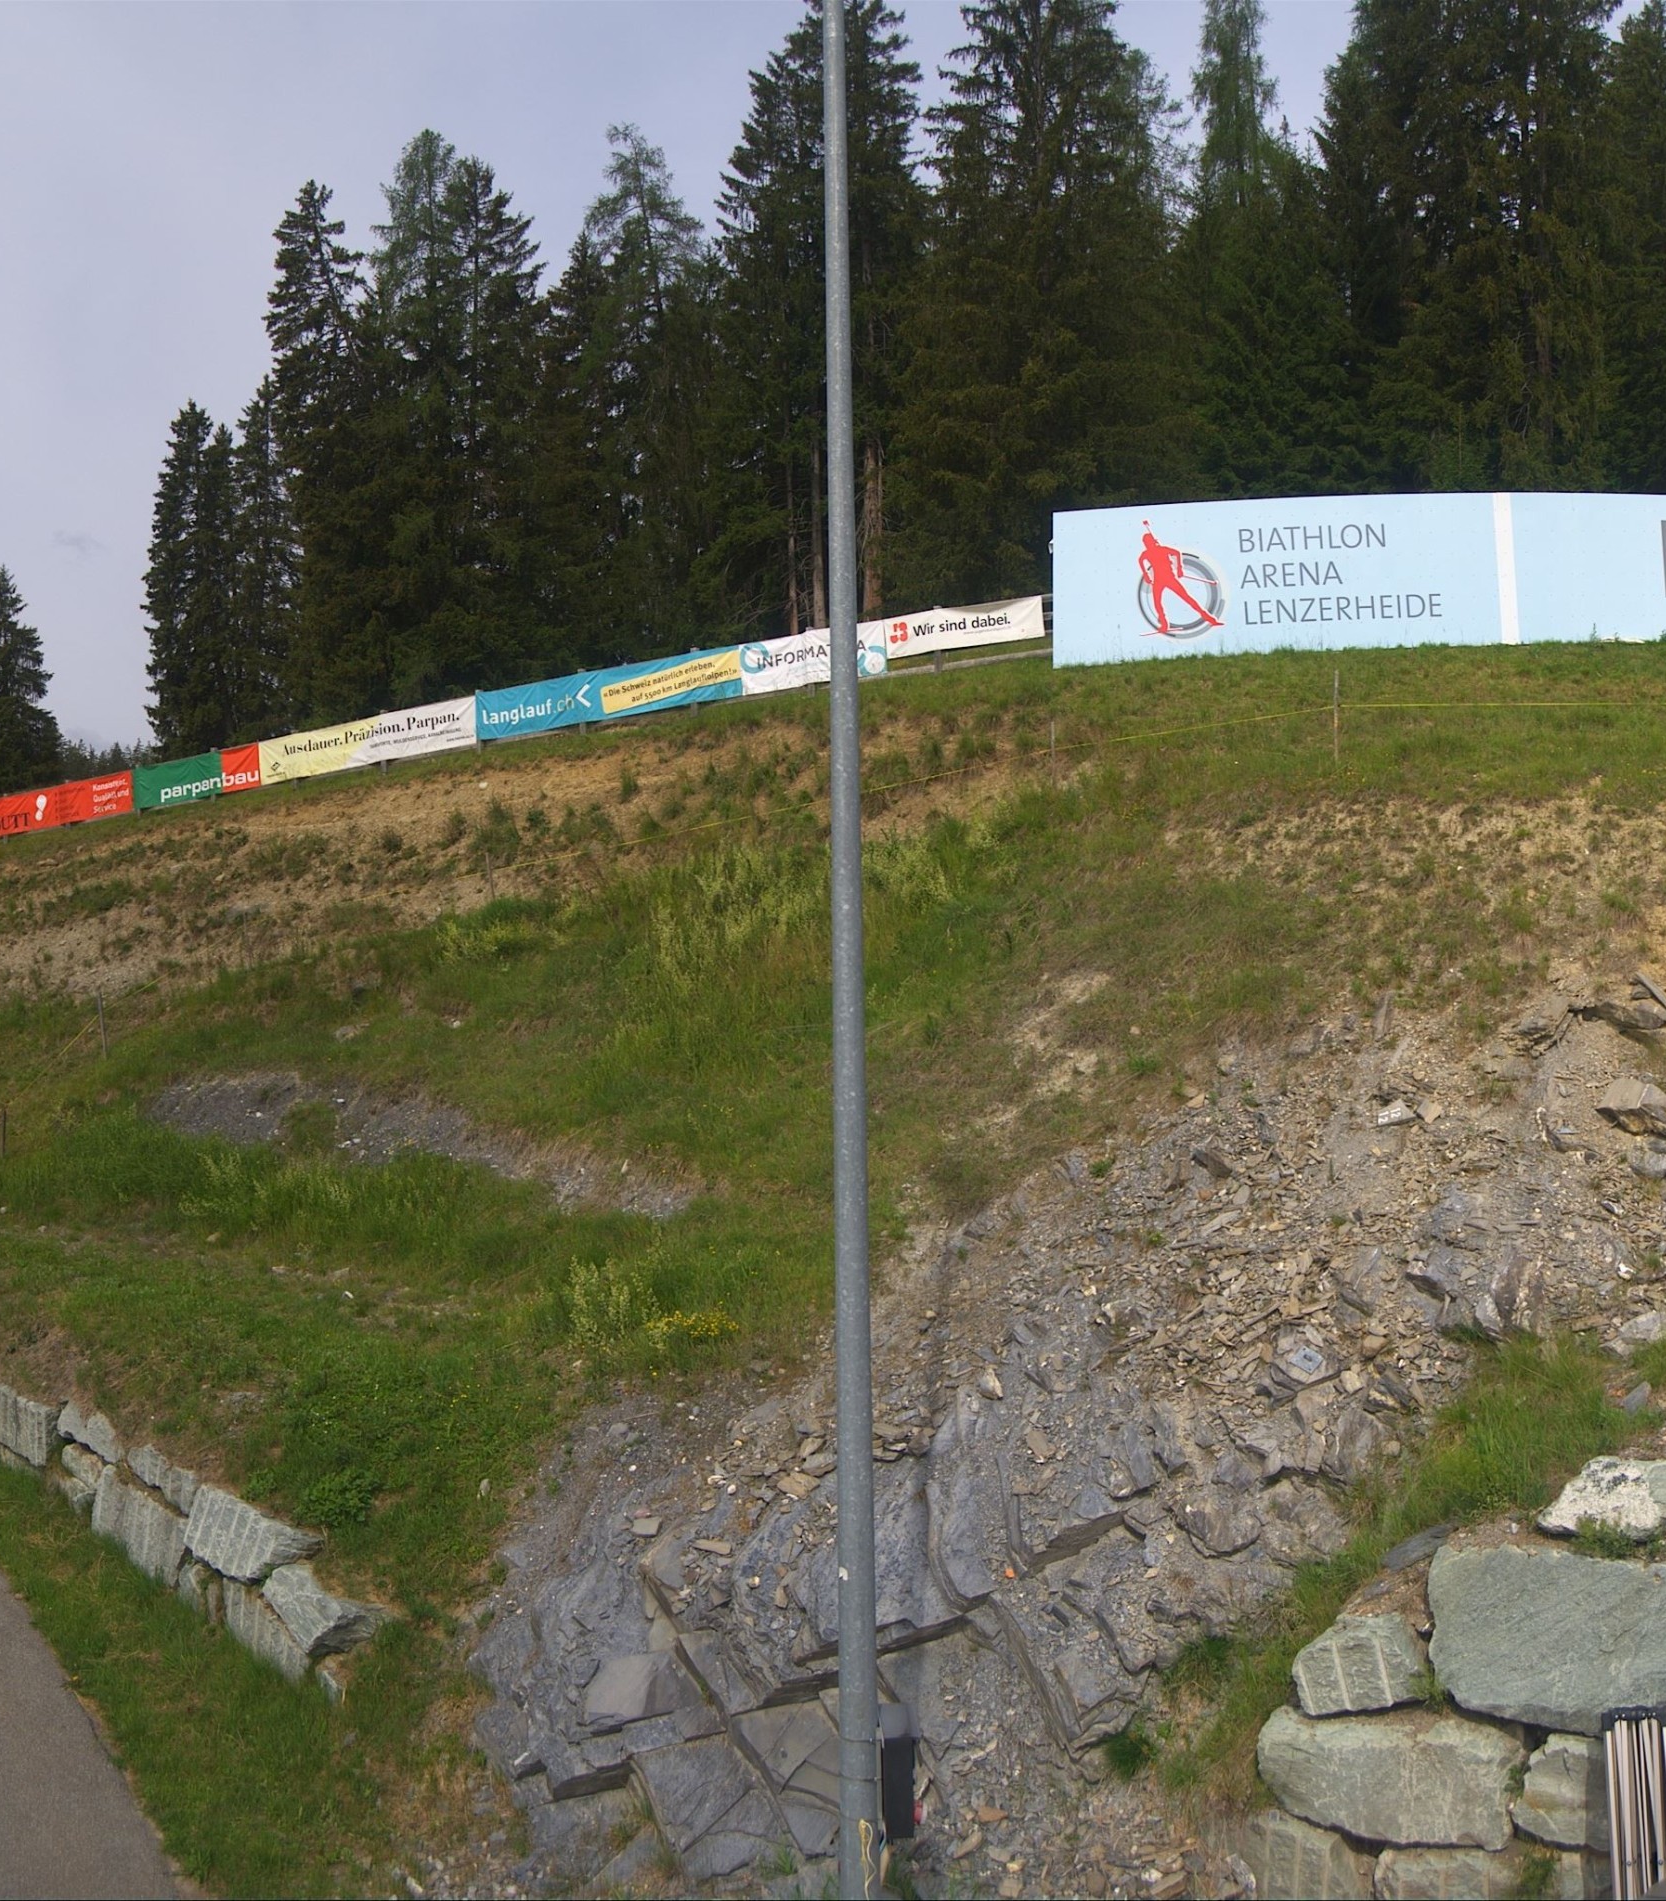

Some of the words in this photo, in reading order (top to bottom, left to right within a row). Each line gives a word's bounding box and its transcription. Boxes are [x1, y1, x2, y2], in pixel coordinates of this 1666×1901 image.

[1238, 523, 1386, 553] BIATHLON
[1240, 561, 1343, 589] ARENA
[1244, 593, 1443, 625] LENZERHEIDE
[913, 624, 935, 637] Wir
[939, 617, 967, 632] sind
[971, 612, 1011, 629] dabei.
[662, 685, 674, 693] km
[482, 694, 575, 724] langlauf.ch
[283, 735, 343, 757] Ausdauer.
[344, 722, 405, 744] Präzision.
[406, 712, 460, 731] Parpan.
[160, 769, 260, 803] parpanbau
